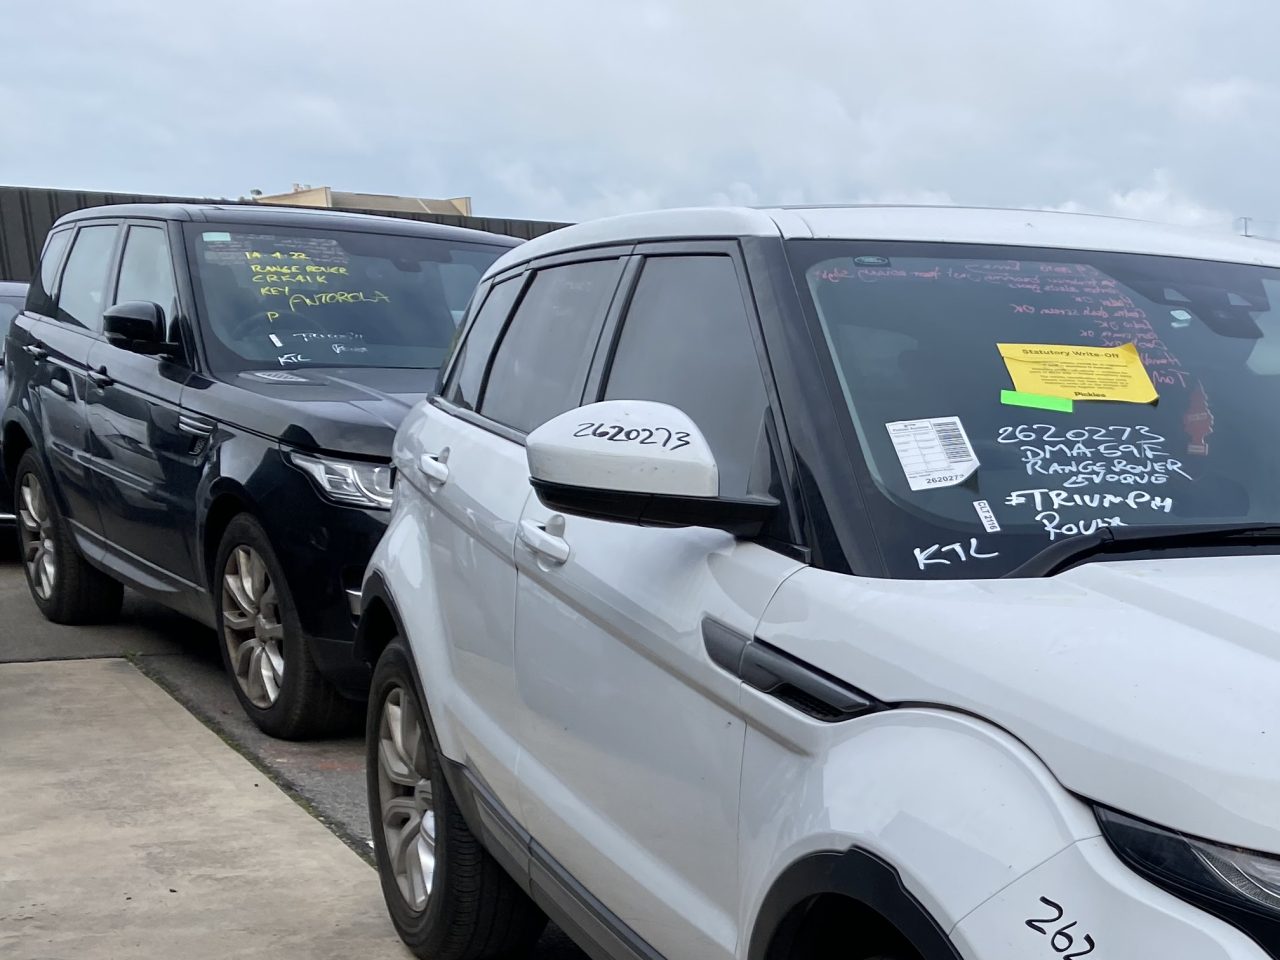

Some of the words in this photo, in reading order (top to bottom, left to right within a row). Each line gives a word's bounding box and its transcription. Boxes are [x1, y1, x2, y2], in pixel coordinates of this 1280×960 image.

[251, 264, 300, 274] RANGE
[305, 264, 350, 275] ROVER
[1022, 348, 1071, 357] Statutory
[1072, 350, 1120, 359] Write-Off
[573, 422, 691, 451] 2620273
[997, 424, 1166, 443] 2620273
[1026, 459, 1106, 475] RANGE
[1111, 459, 1193, 481] ROVER
[977, 501, 991, 514] CLT
